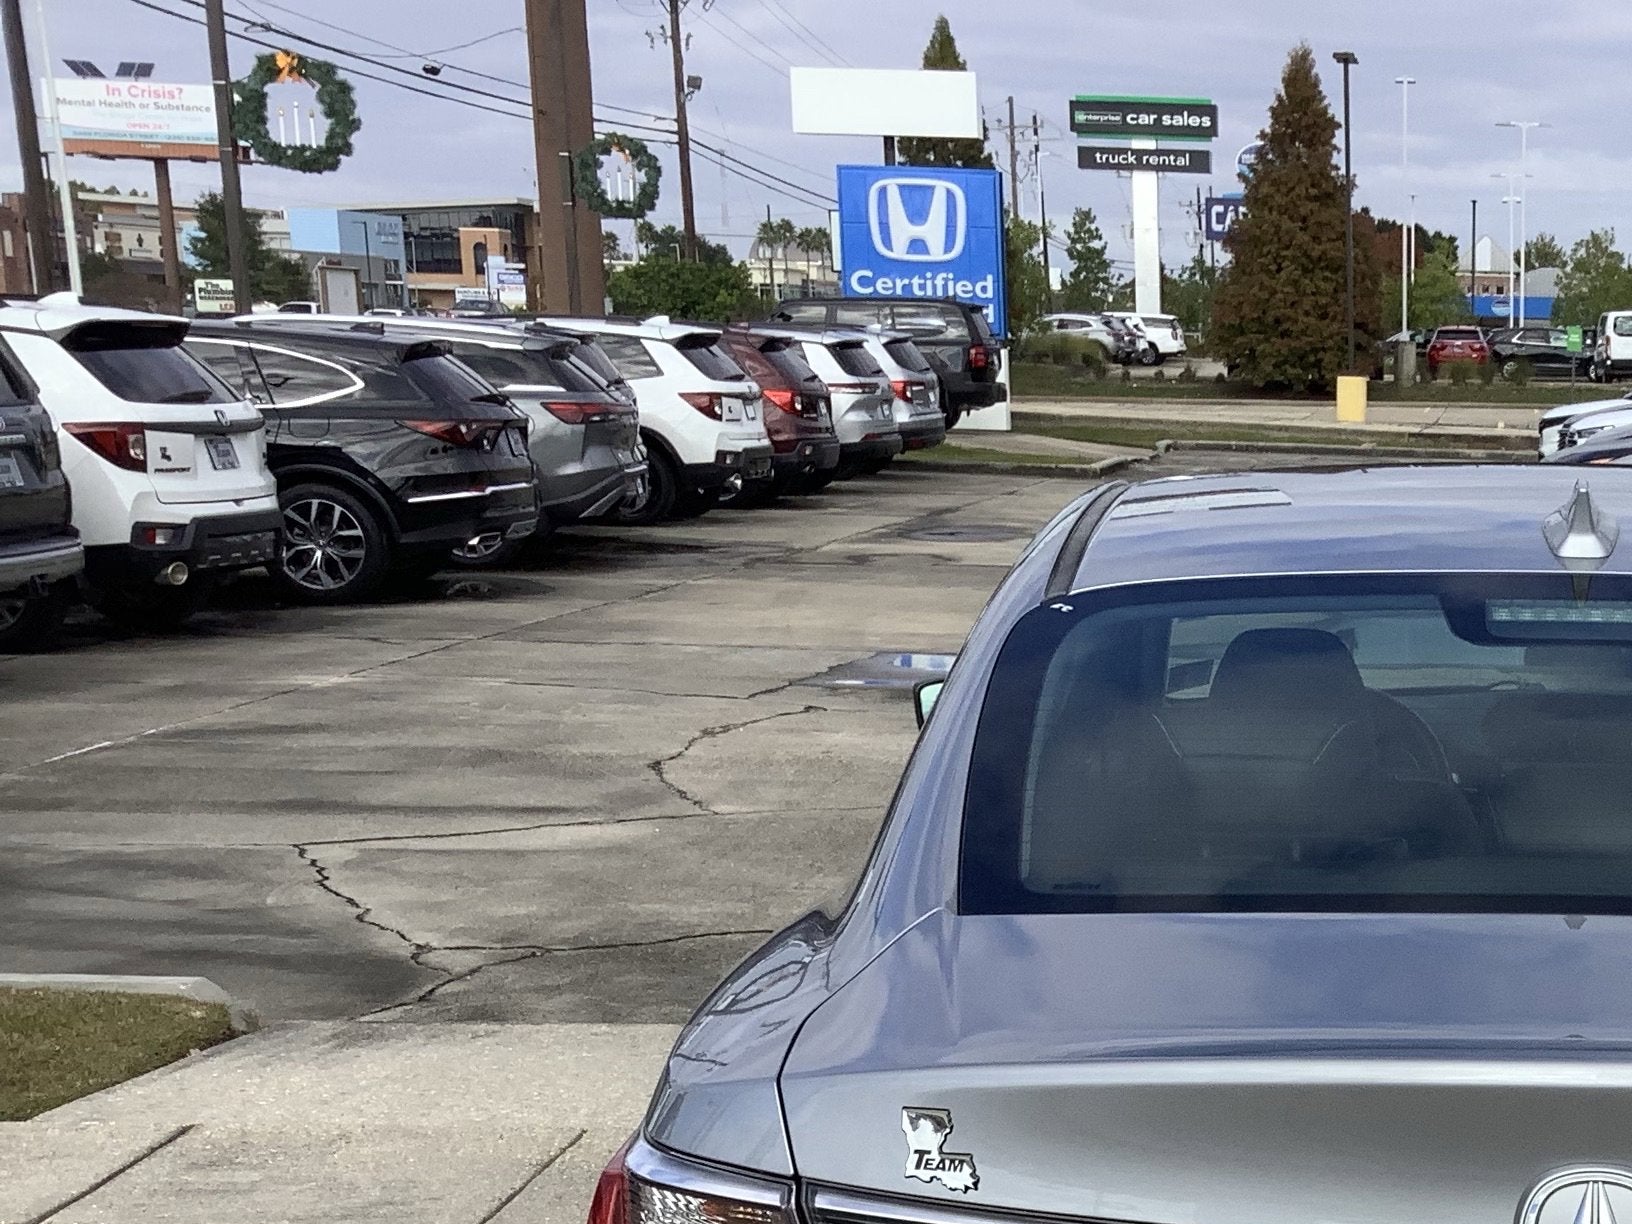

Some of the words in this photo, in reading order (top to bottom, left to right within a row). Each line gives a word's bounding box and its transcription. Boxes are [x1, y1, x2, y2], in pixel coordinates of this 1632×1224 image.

[106, 84, 121, 97] In
[127, 85, 183, 100] Crisis?
[57, 97, 96, 107] Mental
[99, 98, 135, 109] Health
[153, 101, 211, 113] Substance
[1076, 112, 1121, 123] enterprise
[1126, 113, 1157, 125] car
[1162, 111, 1211, 127] sales
[1095, 151, 1137, 165] truck
[1143, 153, 1190, 167] rental
[199, 287, 234, 296] Plumbin
[851, 269, 994, 299] Certified
[913, 1149, 965, 1173] TEAM
